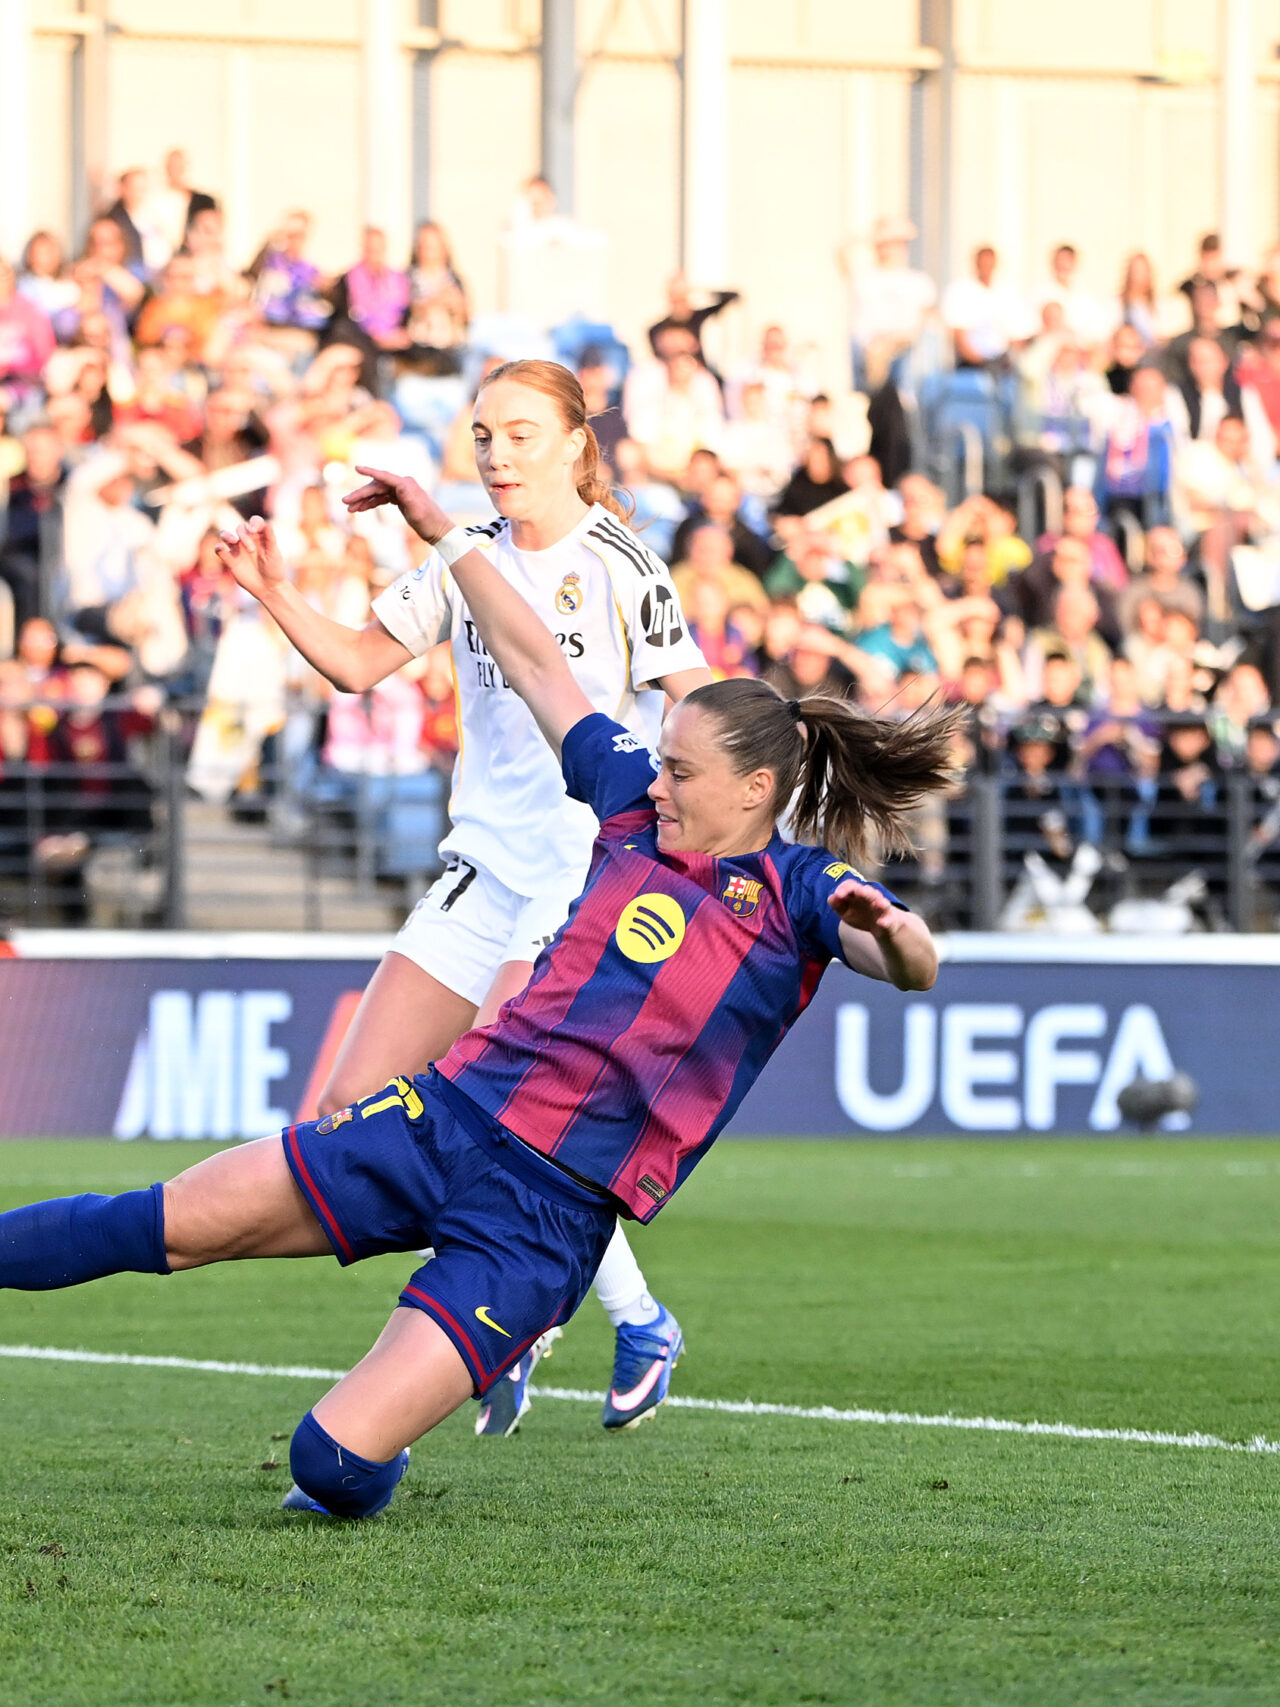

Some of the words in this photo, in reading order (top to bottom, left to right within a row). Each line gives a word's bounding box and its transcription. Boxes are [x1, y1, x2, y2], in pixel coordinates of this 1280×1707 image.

[641, 585, 683, 648] hp
[477, 661, 496, 689] FLY
[835, 1002, 1192, 1132] UEFA
